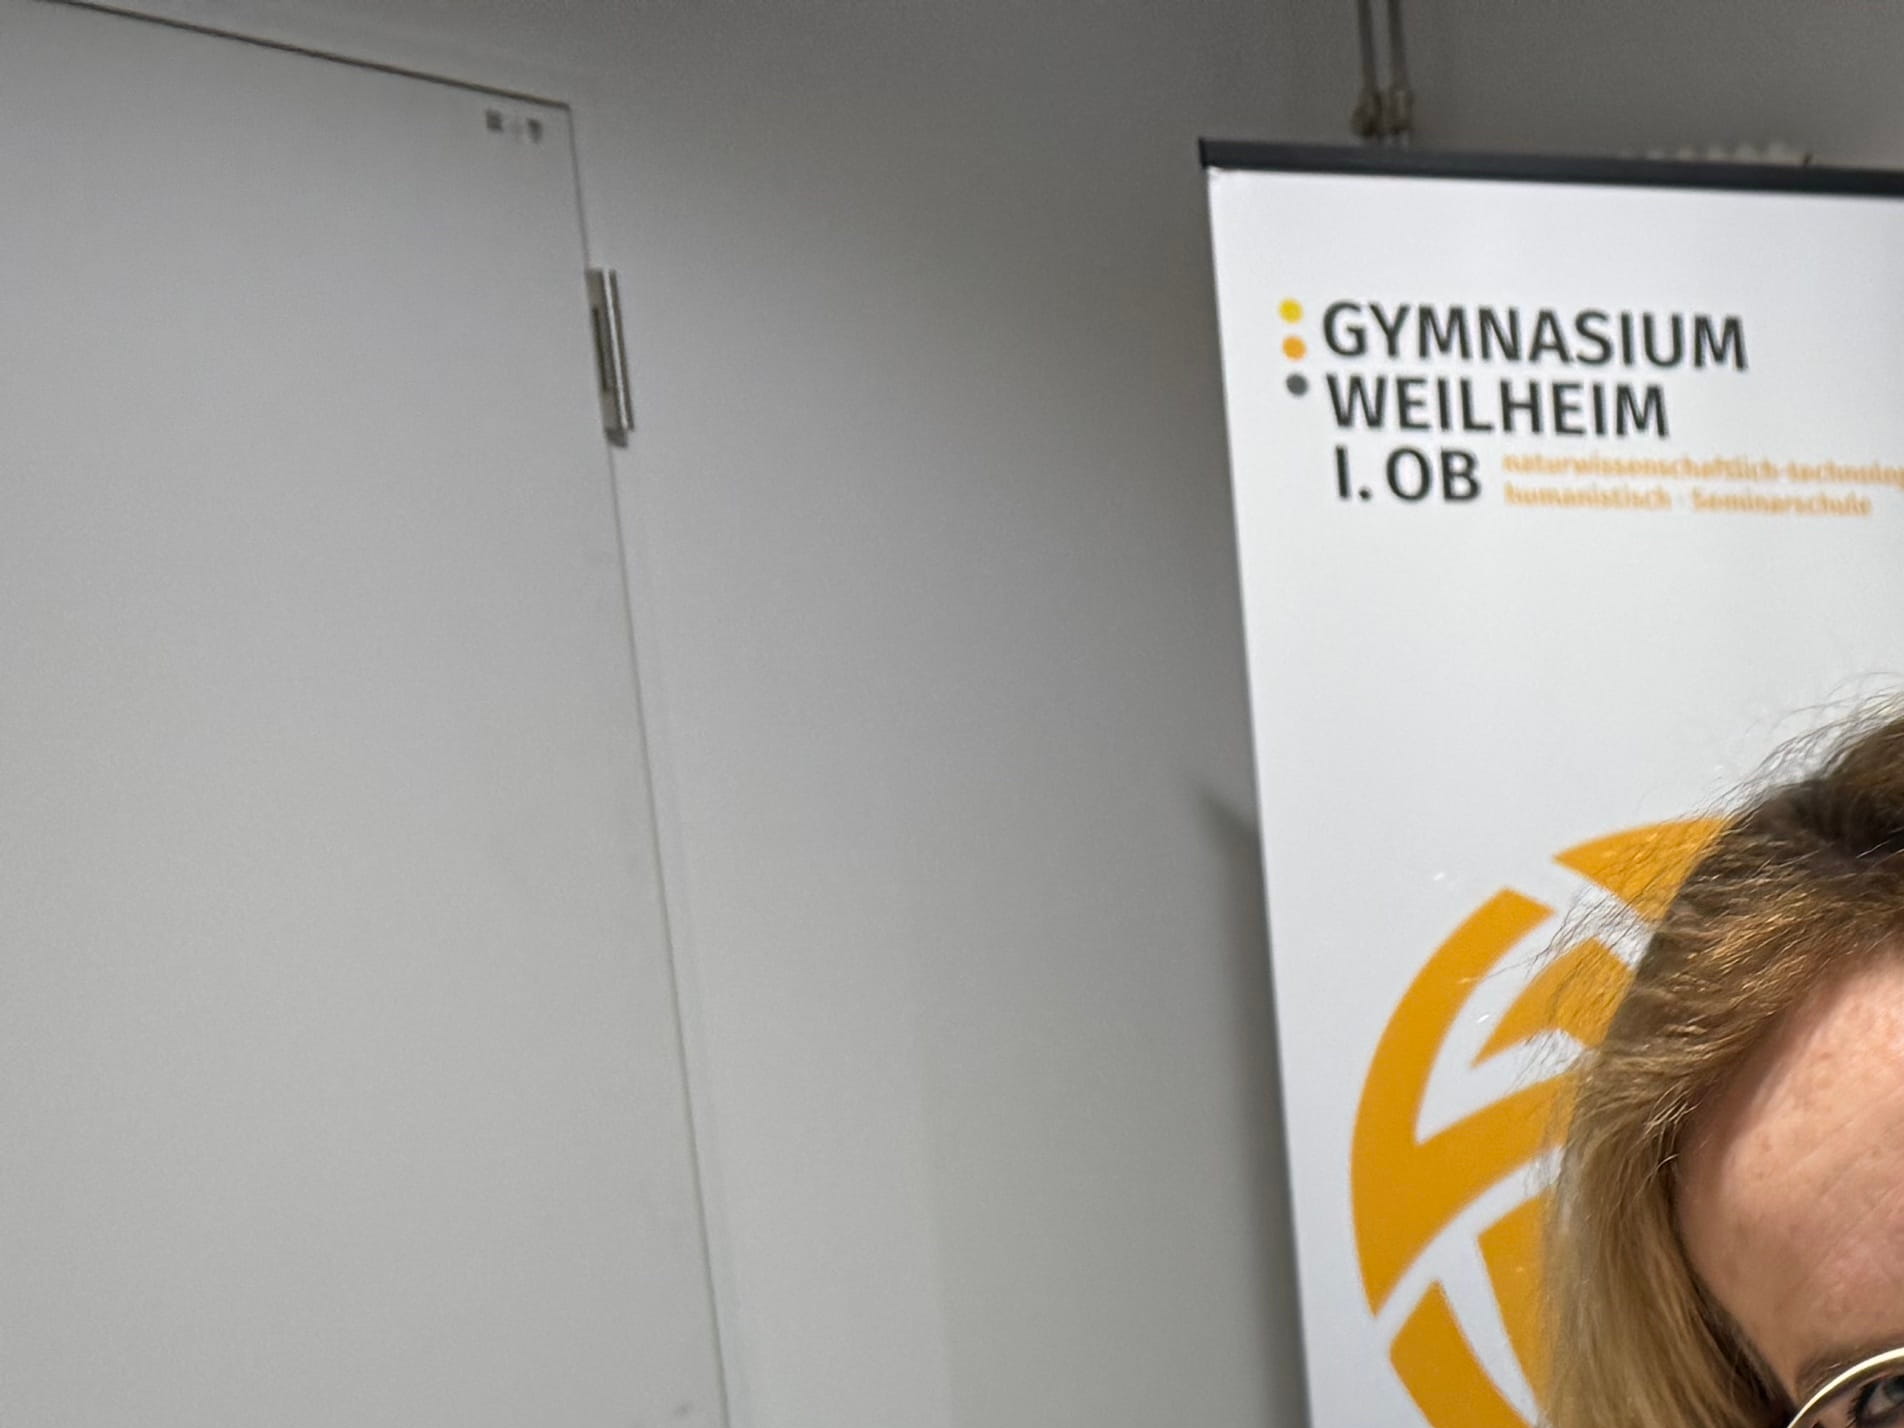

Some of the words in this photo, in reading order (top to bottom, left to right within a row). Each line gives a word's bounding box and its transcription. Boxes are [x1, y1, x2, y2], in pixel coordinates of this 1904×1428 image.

[1322, 300, 1748, 372] GYMNASIUM
[1325, 373, 1670, 438] WEILHEIM
[1335, 446, 1371, 501] I.
[1385, 446, 1481, 503] OB
[1504, 482, 1671, 510] humanistisch
